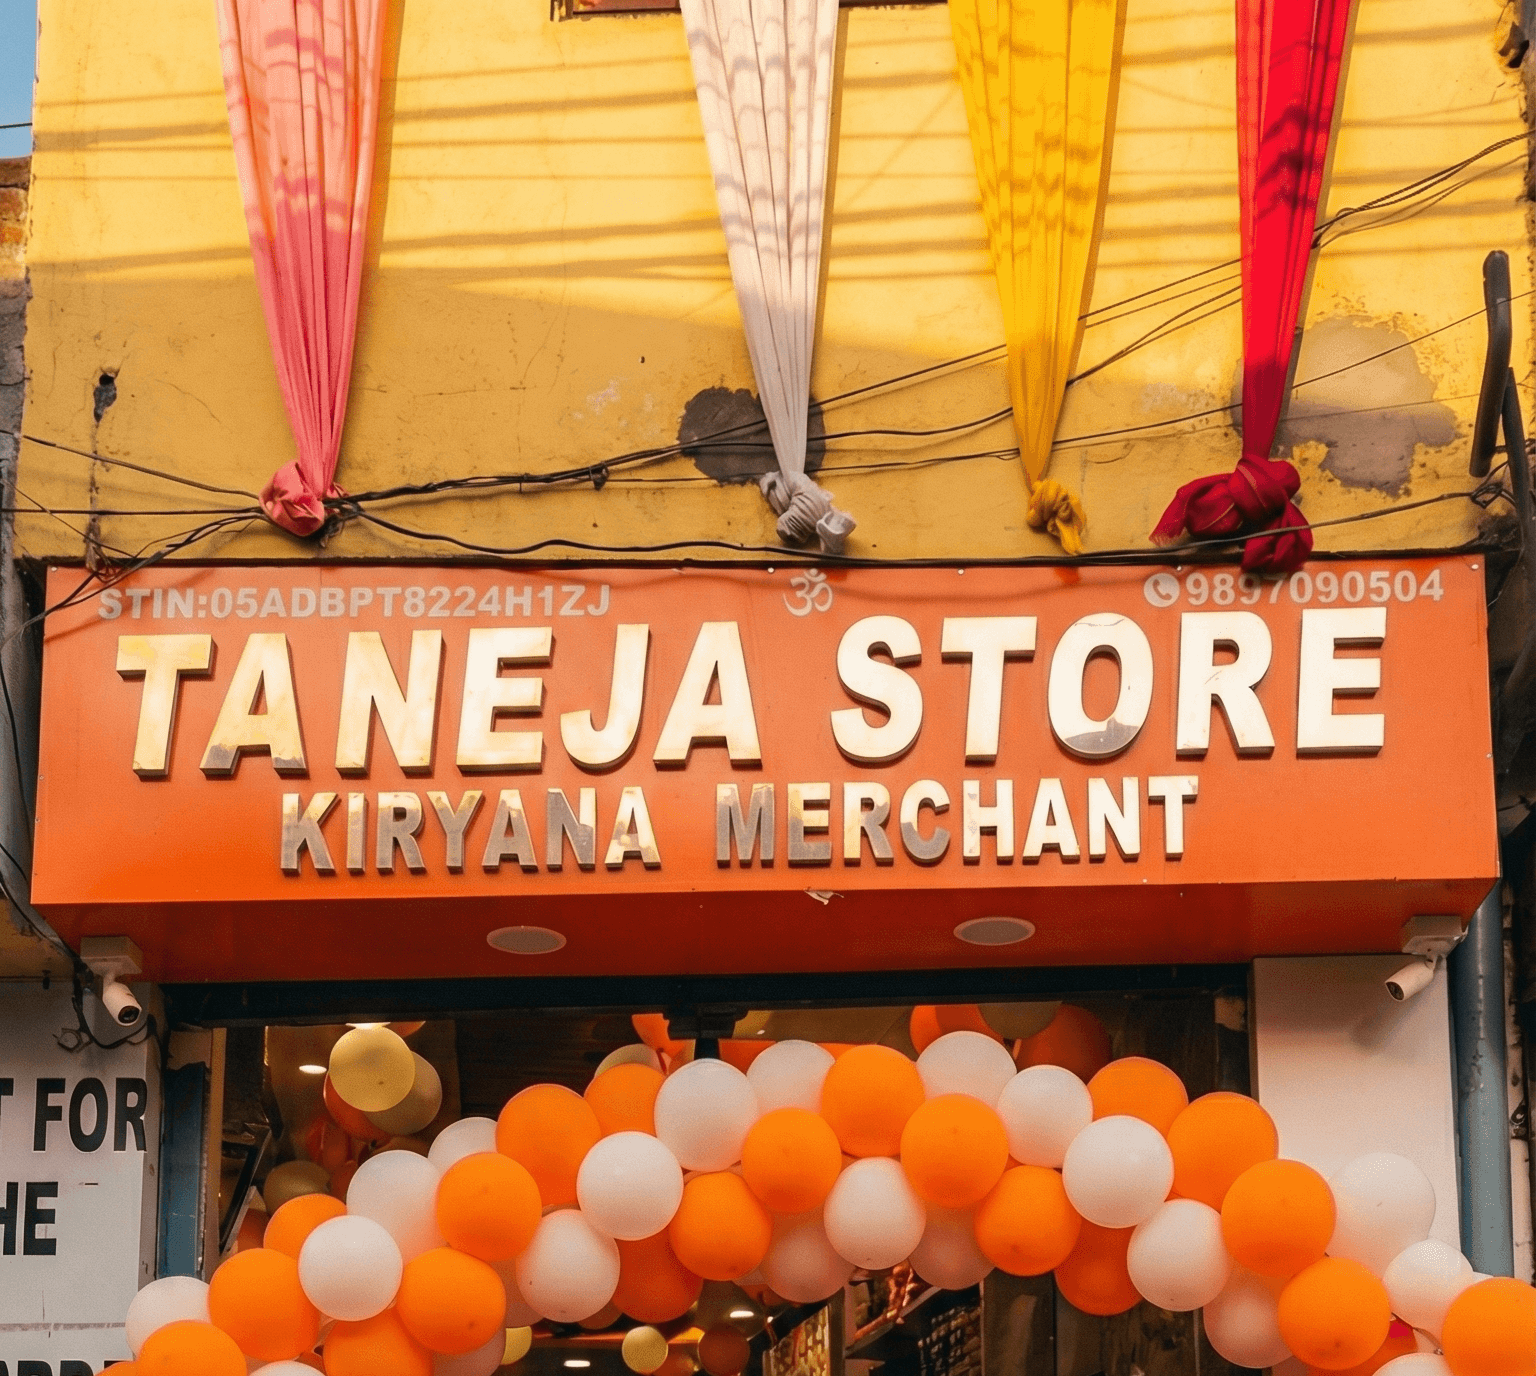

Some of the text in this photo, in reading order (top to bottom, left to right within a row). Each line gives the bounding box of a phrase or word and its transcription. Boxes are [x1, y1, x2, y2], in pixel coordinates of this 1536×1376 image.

[98, 584, 611, 619] STIN:05ADBPT8224H1ZJ
[1185, 569, 1444, 606] 9897090504
[116, 606, 1388, 778] TANEJA STORE
[280, 775, 1199, 875] KIRYANA MERCHANT
[33, 1077, 148, 1152] FOR
